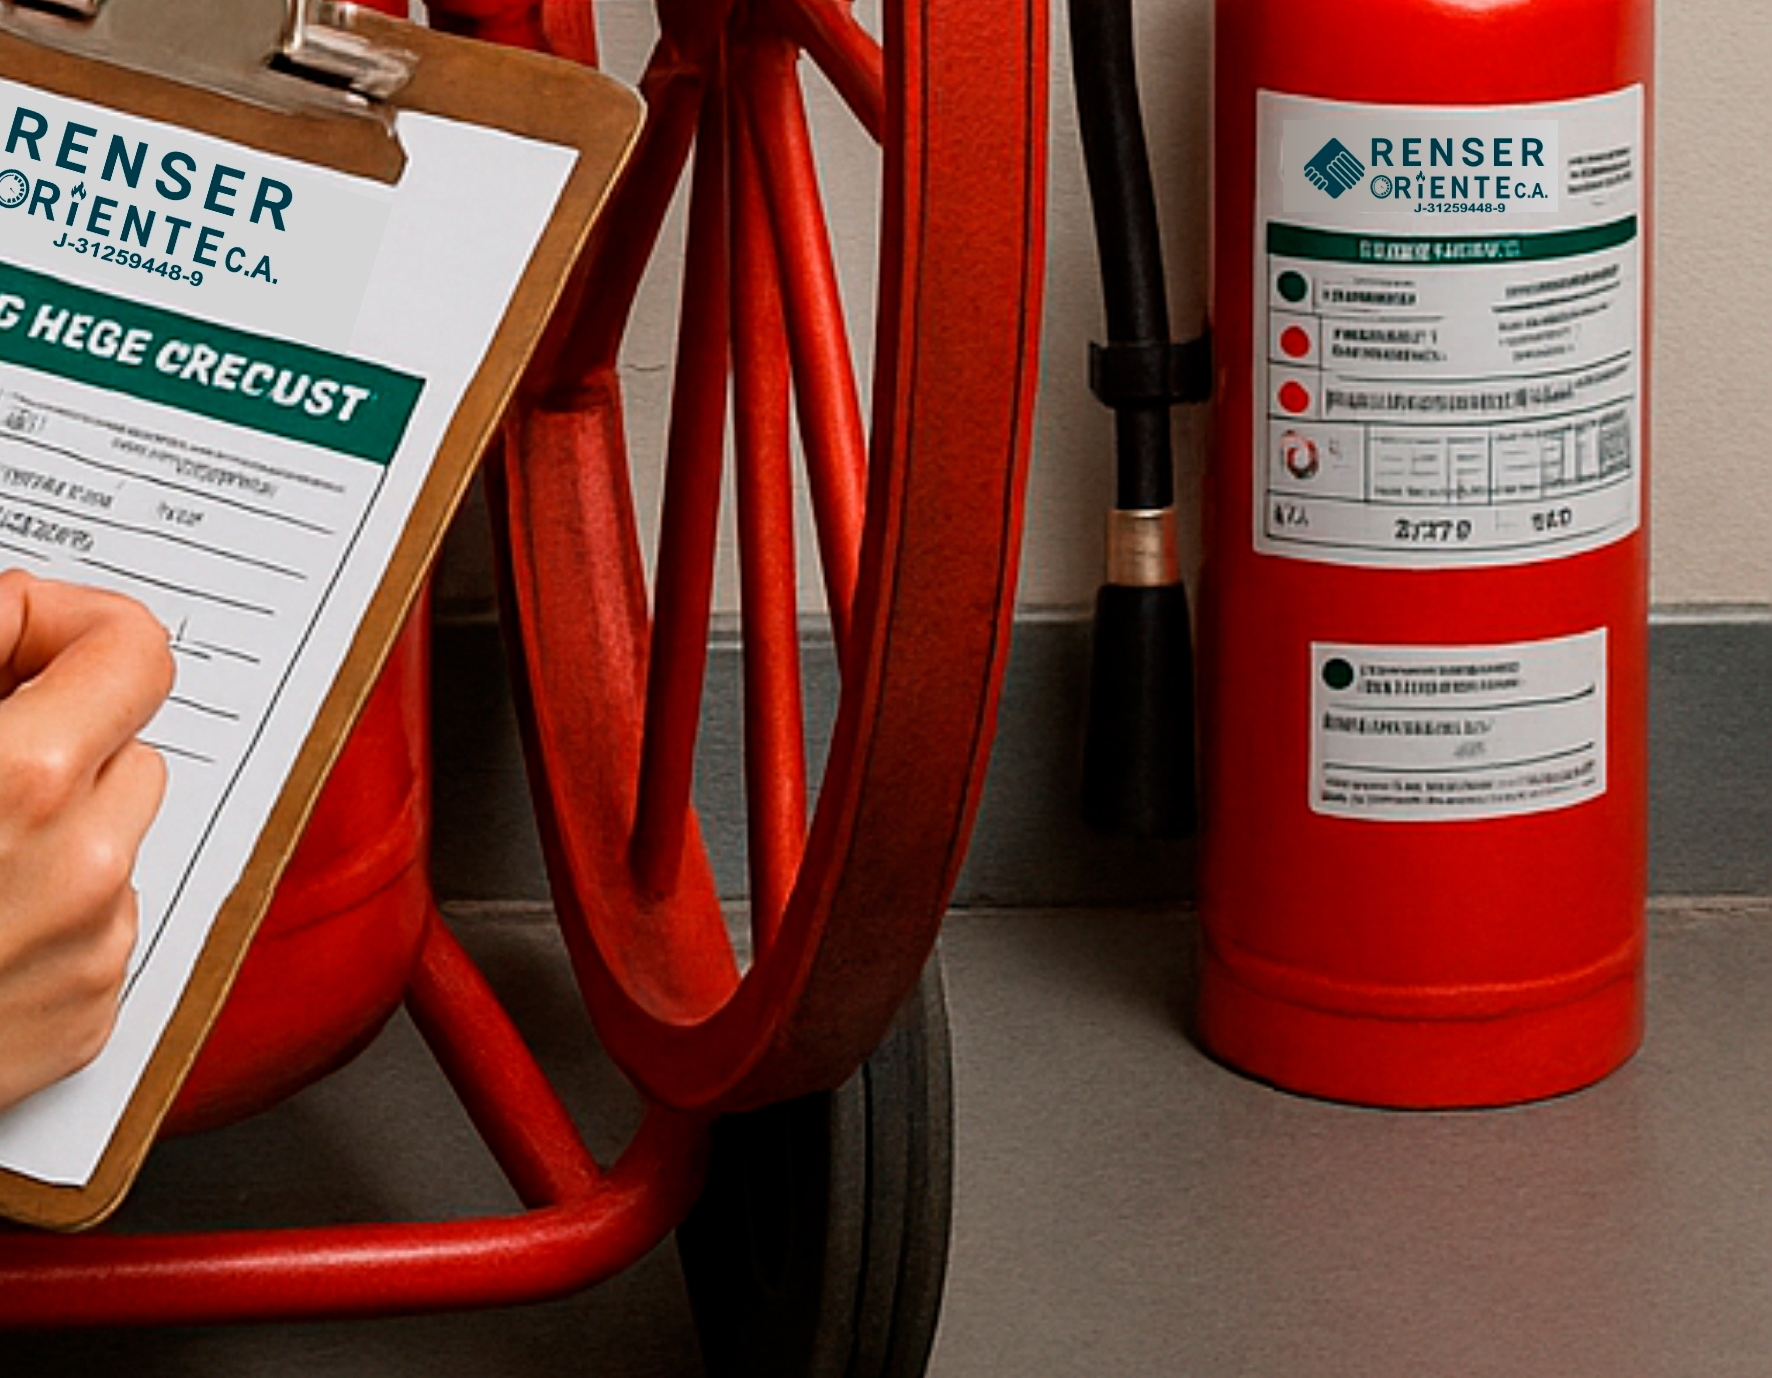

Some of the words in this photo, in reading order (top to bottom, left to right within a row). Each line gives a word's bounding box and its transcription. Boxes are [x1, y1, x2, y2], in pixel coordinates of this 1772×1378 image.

[5, 106, 293, 232] RENSER
[1371, 137, 1545, 167] RENSER
[1414, 202, 1506, 214] J-31259448-9
[52, 232, 204, 288] J-31259448-9
[155, 339, 371, 423] CRECUST
